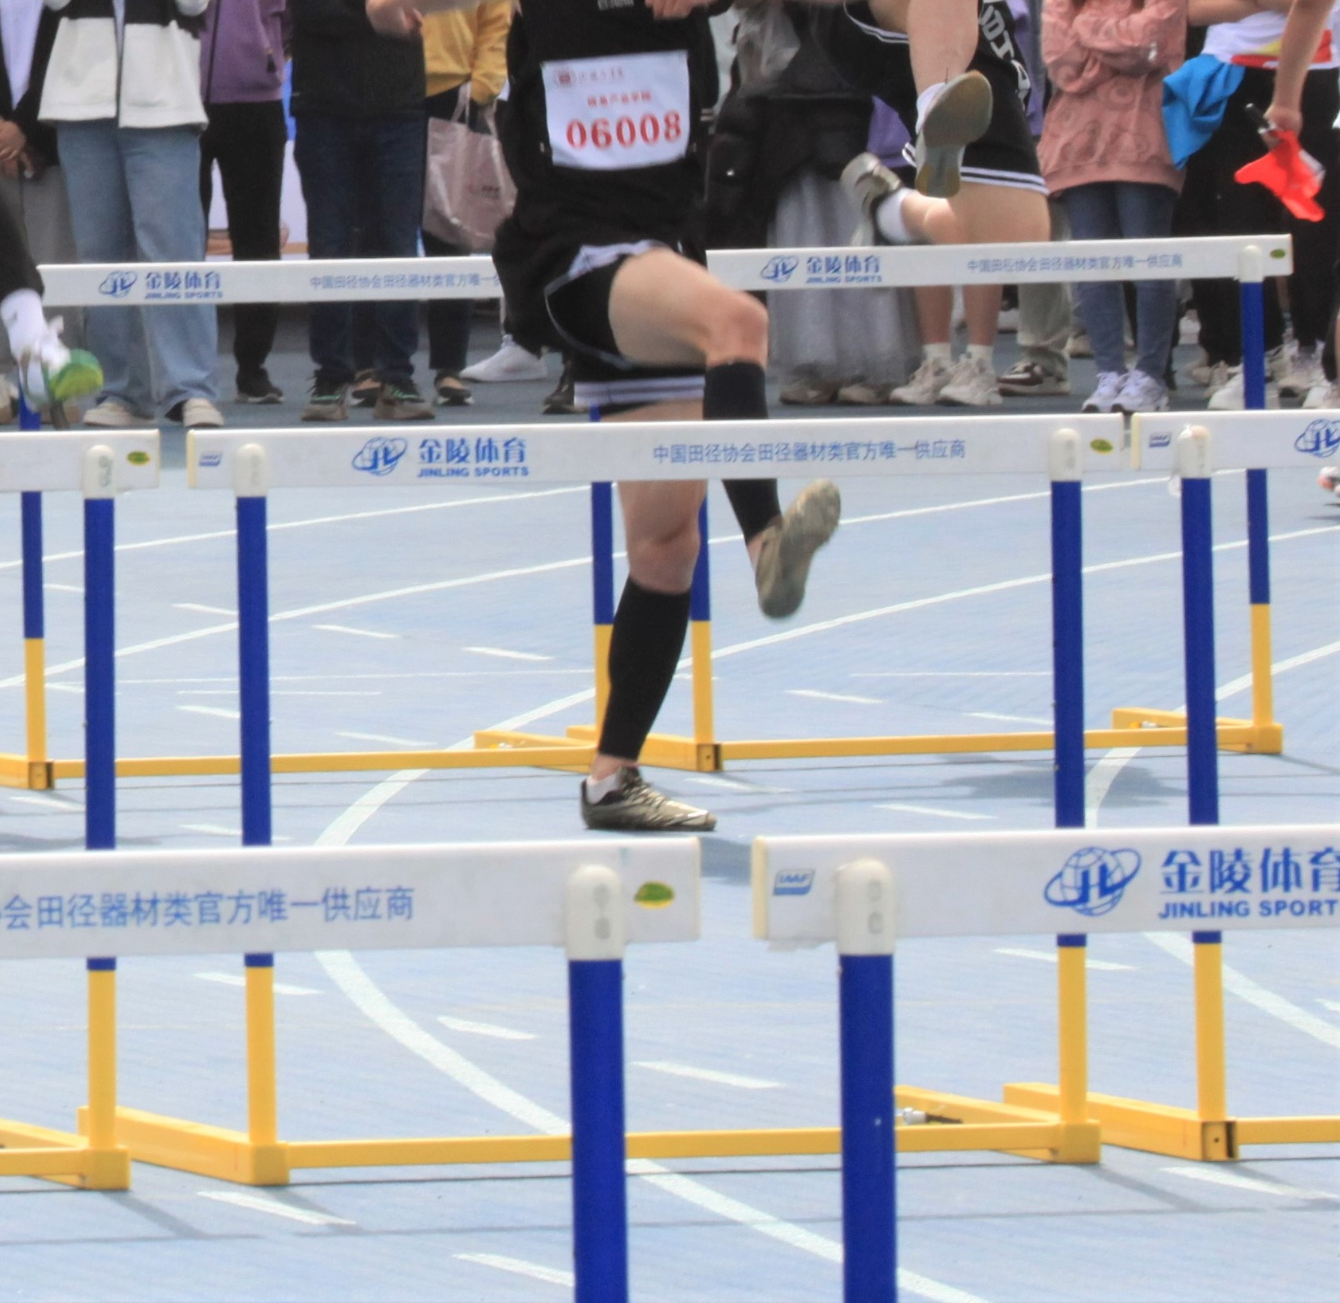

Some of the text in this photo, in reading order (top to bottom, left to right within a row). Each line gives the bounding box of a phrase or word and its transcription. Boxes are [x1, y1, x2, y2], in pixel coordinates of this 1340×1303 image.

[566, 110, 682, 150] 06008
[808, 256, 881, 276] 金陵体育
[144, 272, 221, 292] 金陵体育
[420, 438, 526, 465] 金陵体育
[653, 440, 965, 465] 中国田径协会田径器材类官方唯一供应商
[419, 467, 529, 477] JINLING SPORTS
[1162, 846, 1340, 895] 金陵体育
[1160, 901, 1250, 919] JINLING
